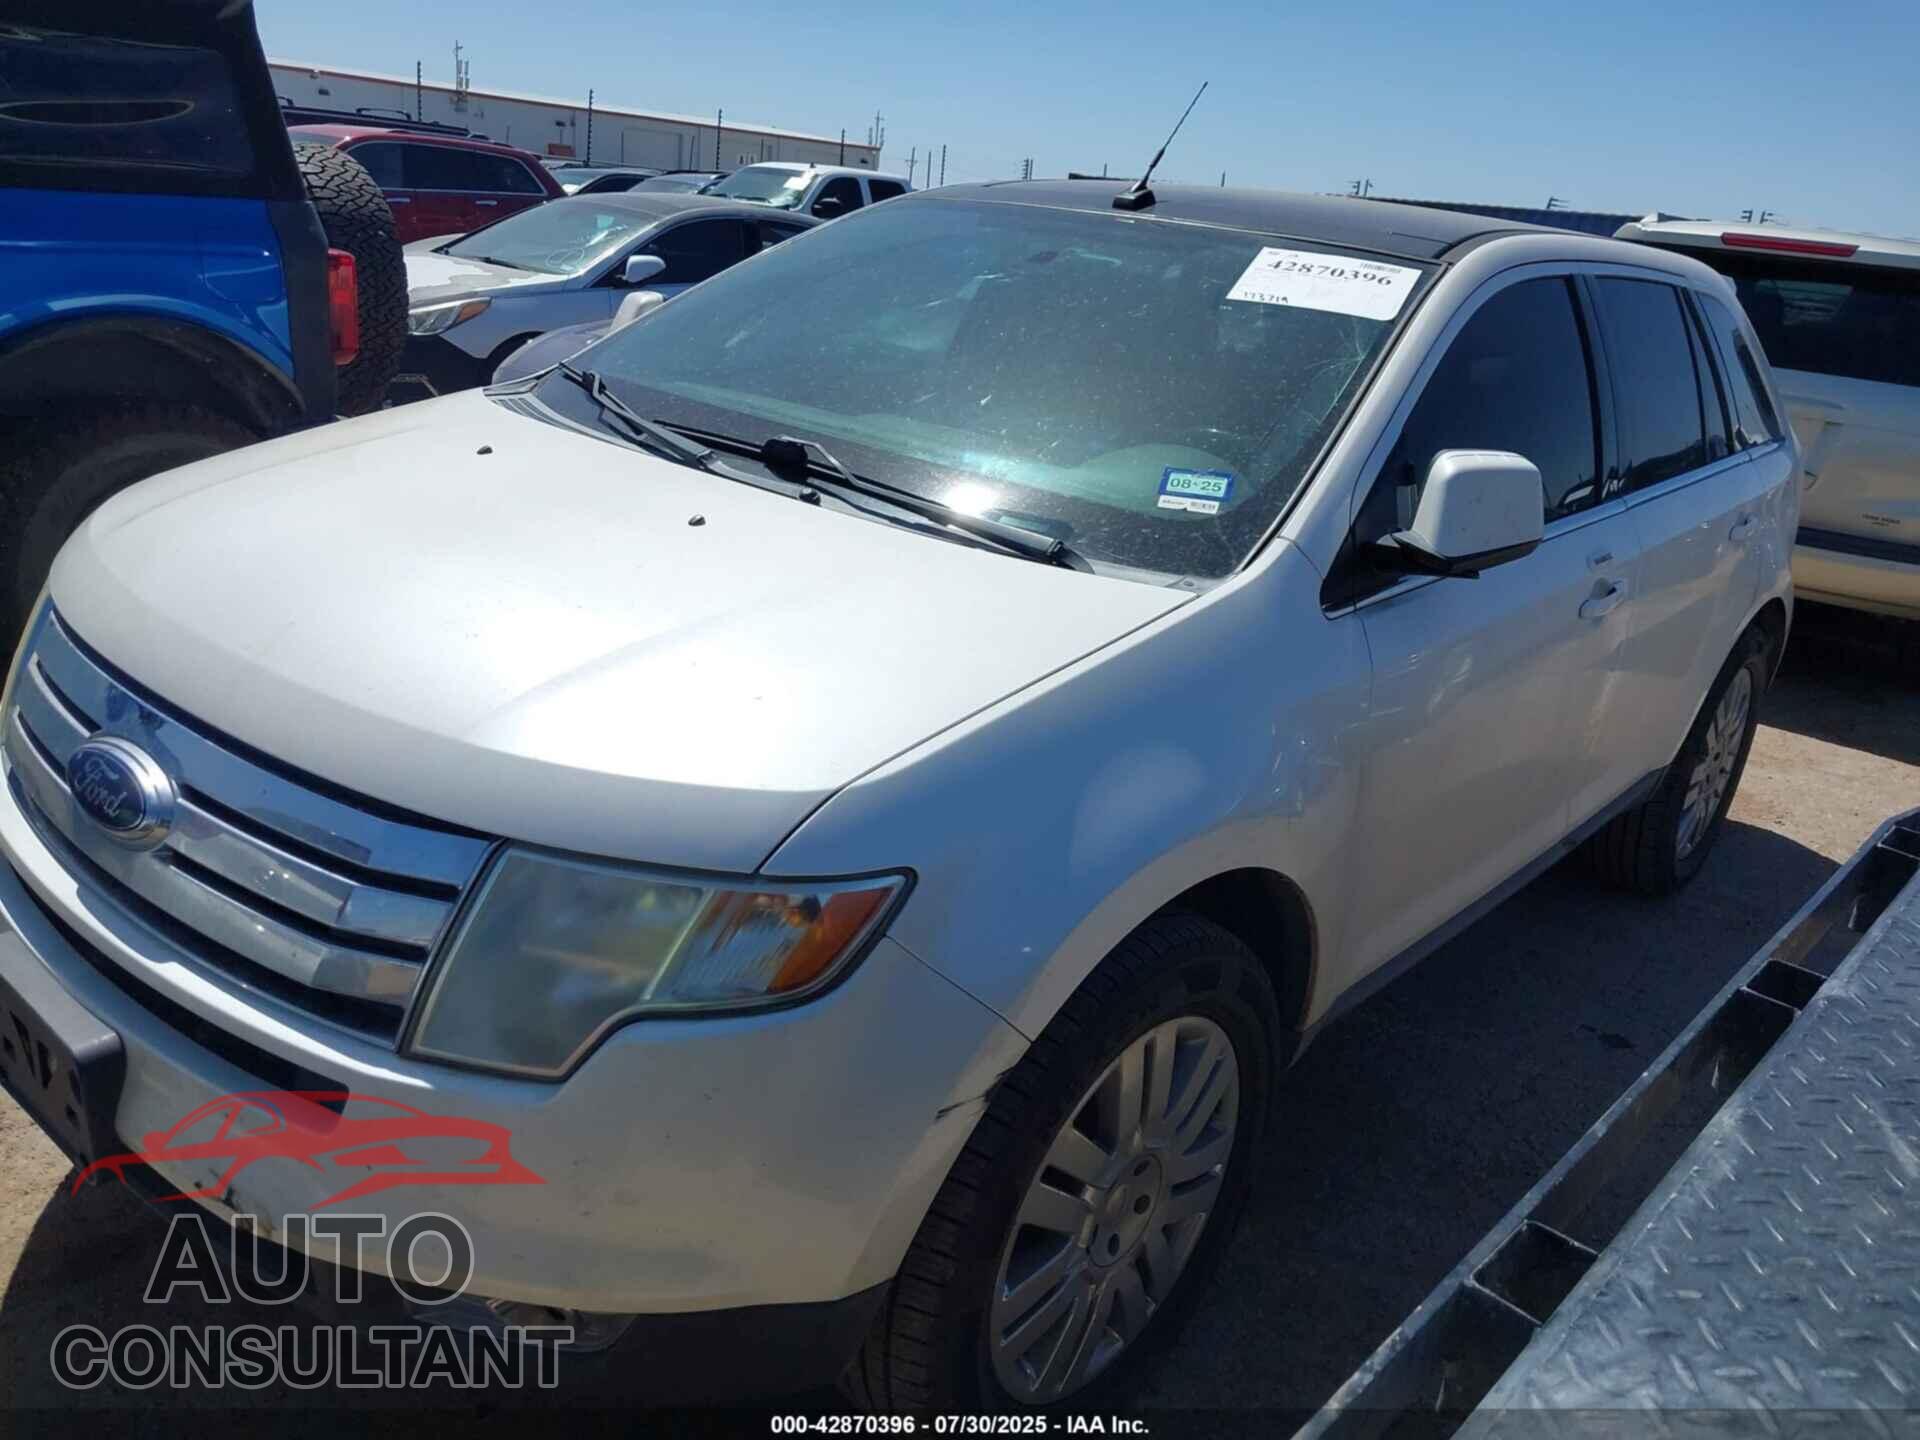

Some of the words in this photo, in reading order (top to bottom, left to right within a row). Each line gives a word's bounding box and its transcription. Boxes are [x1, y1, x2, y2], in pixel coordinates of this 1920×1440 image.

[1267, 259, 1393, 287] 42870396
[1170, 478, 1192, 489] 08
[1200, 480, 1223, 492] 25
[74, 758, 128, 817] Ford
